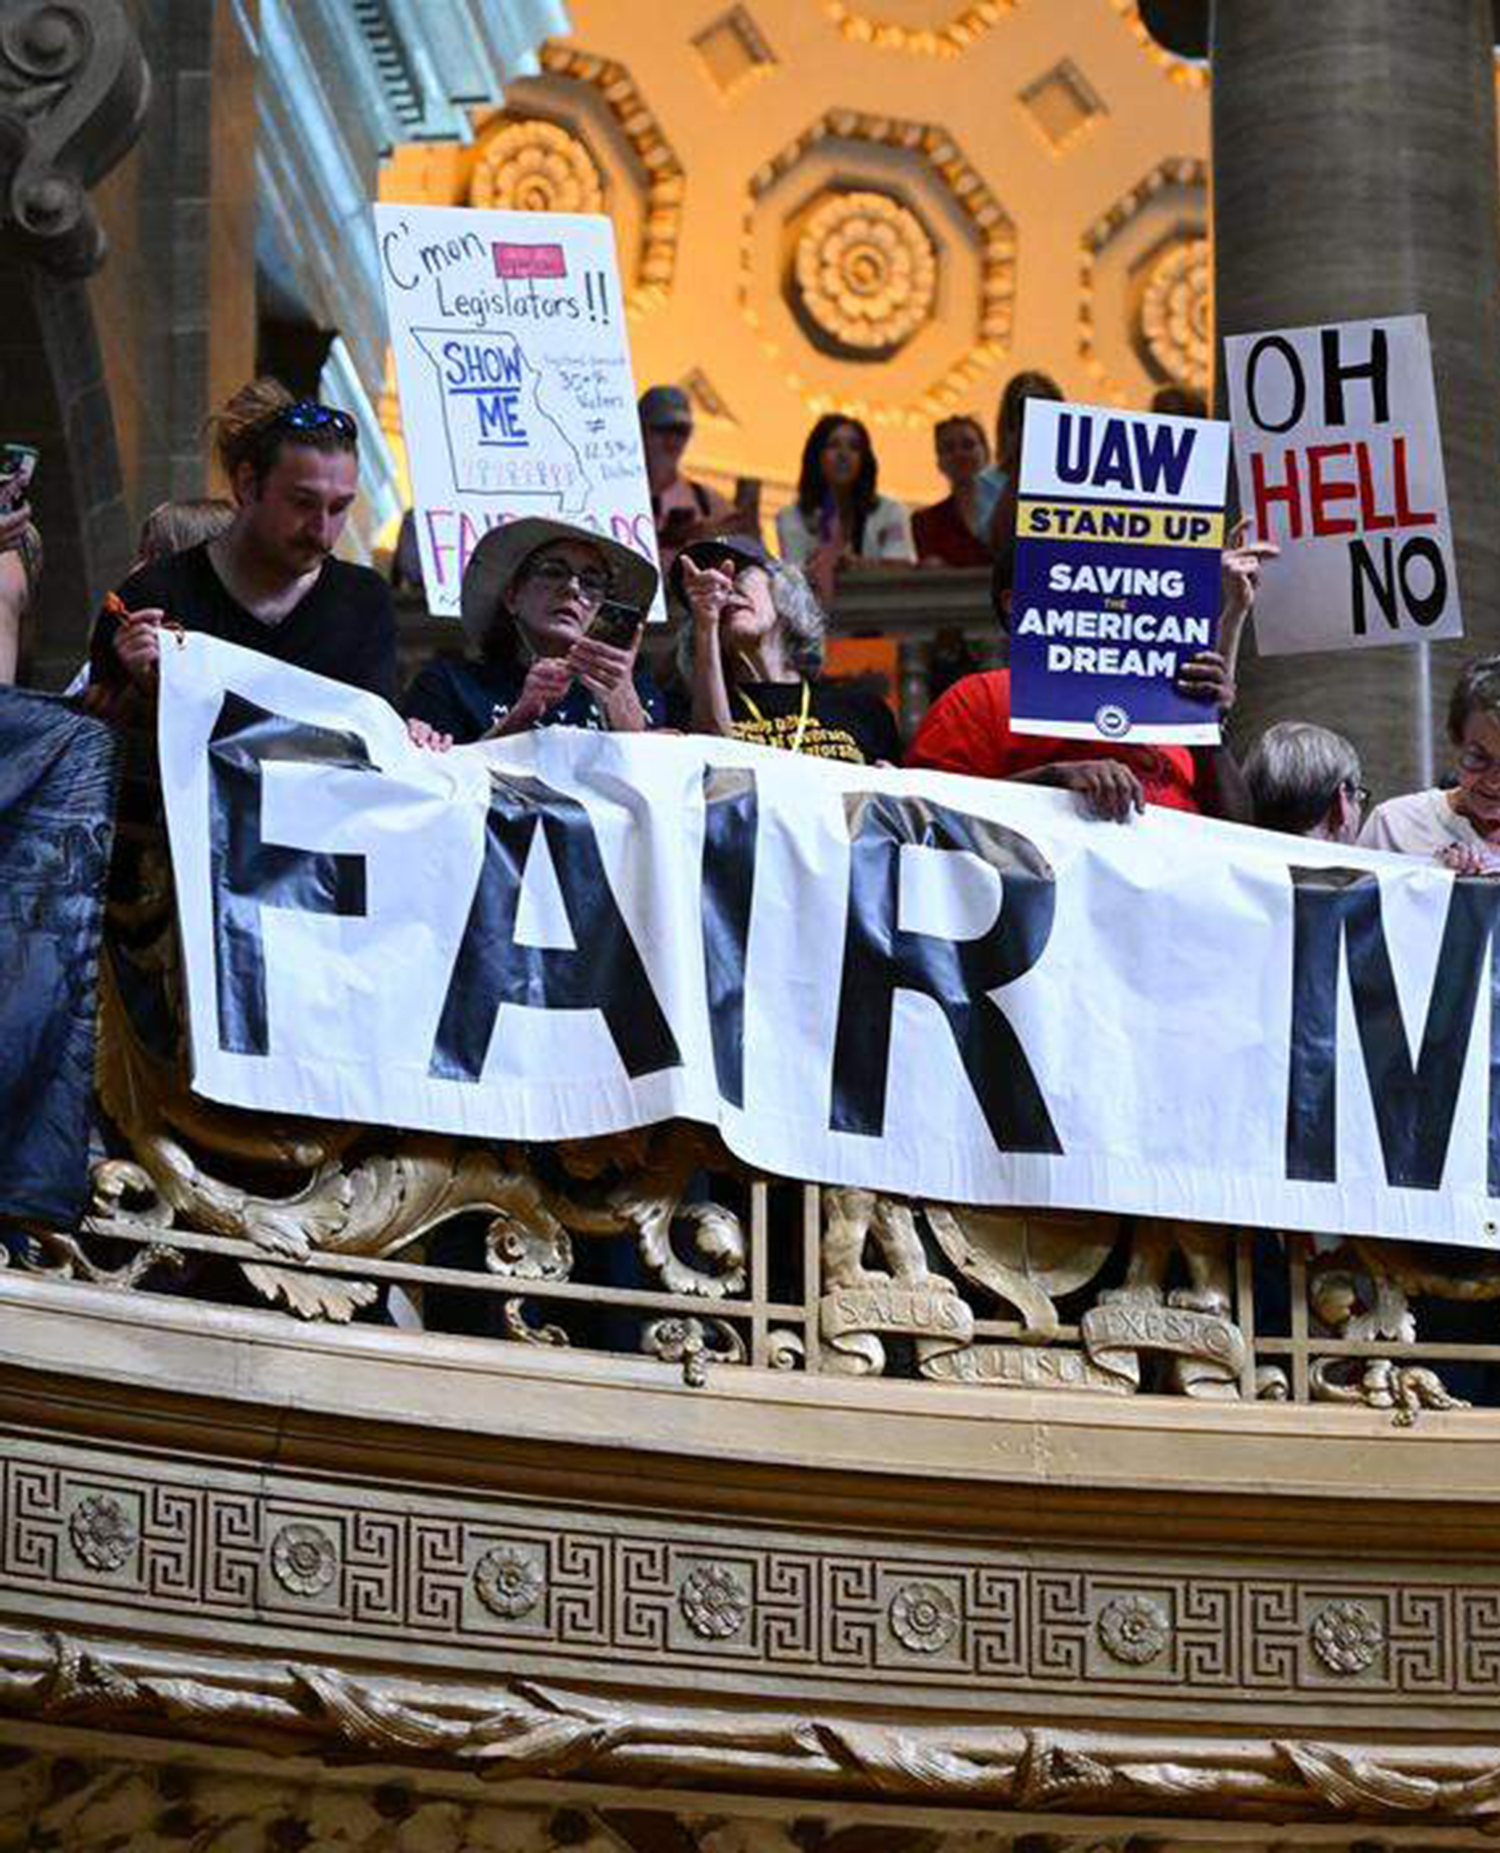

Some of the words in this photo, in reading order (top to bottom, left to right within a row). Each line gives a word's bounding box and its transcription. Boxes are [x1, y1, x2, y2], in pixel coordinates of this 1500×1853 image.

[443, 342, 522, 384] SHOW
[1246, 329, 1389, 433] OH
[477, 397, 527, 438] ME
[1055, 413, 1196, 496] UAW
[1250, 437, 1436, 541] HELL
[1029, 508, 1151, 540] STAND
[1163, 515, 1211, 543] UP
[1048, 564, 1185, 599] SAVING
[1349, 536, 1448, 636] NO
[1018, 608, 1210, 646] AMERICAN
[1047, 646, 1175, 678] DREAM
[206, 689, 1065, 1156] FAIR
